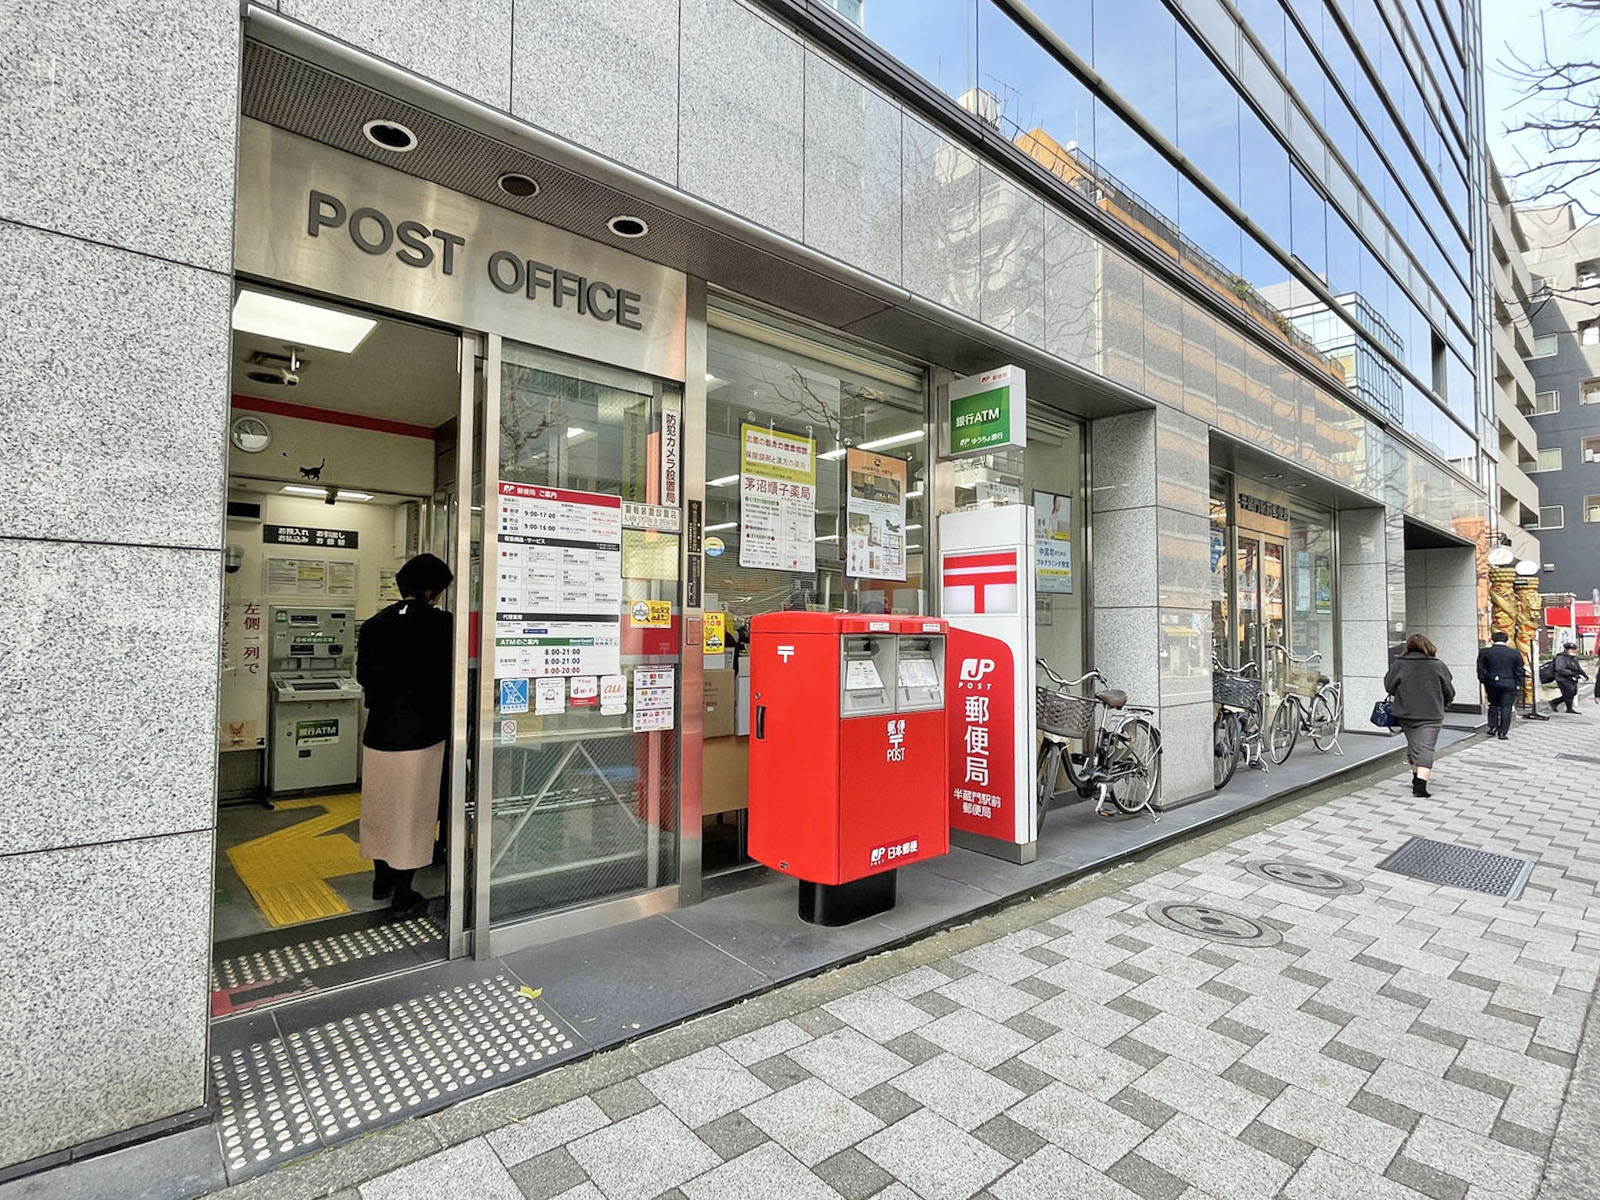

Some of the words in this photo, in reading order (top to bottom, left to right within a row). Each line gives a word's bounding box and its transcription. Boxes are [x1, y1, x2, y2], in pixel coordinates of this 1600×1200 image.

[308, 189, 465, 275] POST
[487, 250, 643, 330] OFFICE
[955, 407, 1000, 427] 銀行ATM
[971, 431, 1003, 445] ゆうちょ銀行
[666, 413, 677, 504] 防犯カメラ設置局
[744, 477, 811, 500] 茅沼順子薬局
[243, 602, 261, 675] 左側一列で
[603, 682, 625, 693] au
[958, 682, 992, 690] POST
[887, 719, 906, 736] 郵便
[964, 695, 990, 787] 郵便局
[887, 748, 905, 762] POST
[953, 788, 1001, 809] 半蔵門駅前
[962, 802, 992, 819] 郵便局
[888, 839, 918, 861] 日本郵便
